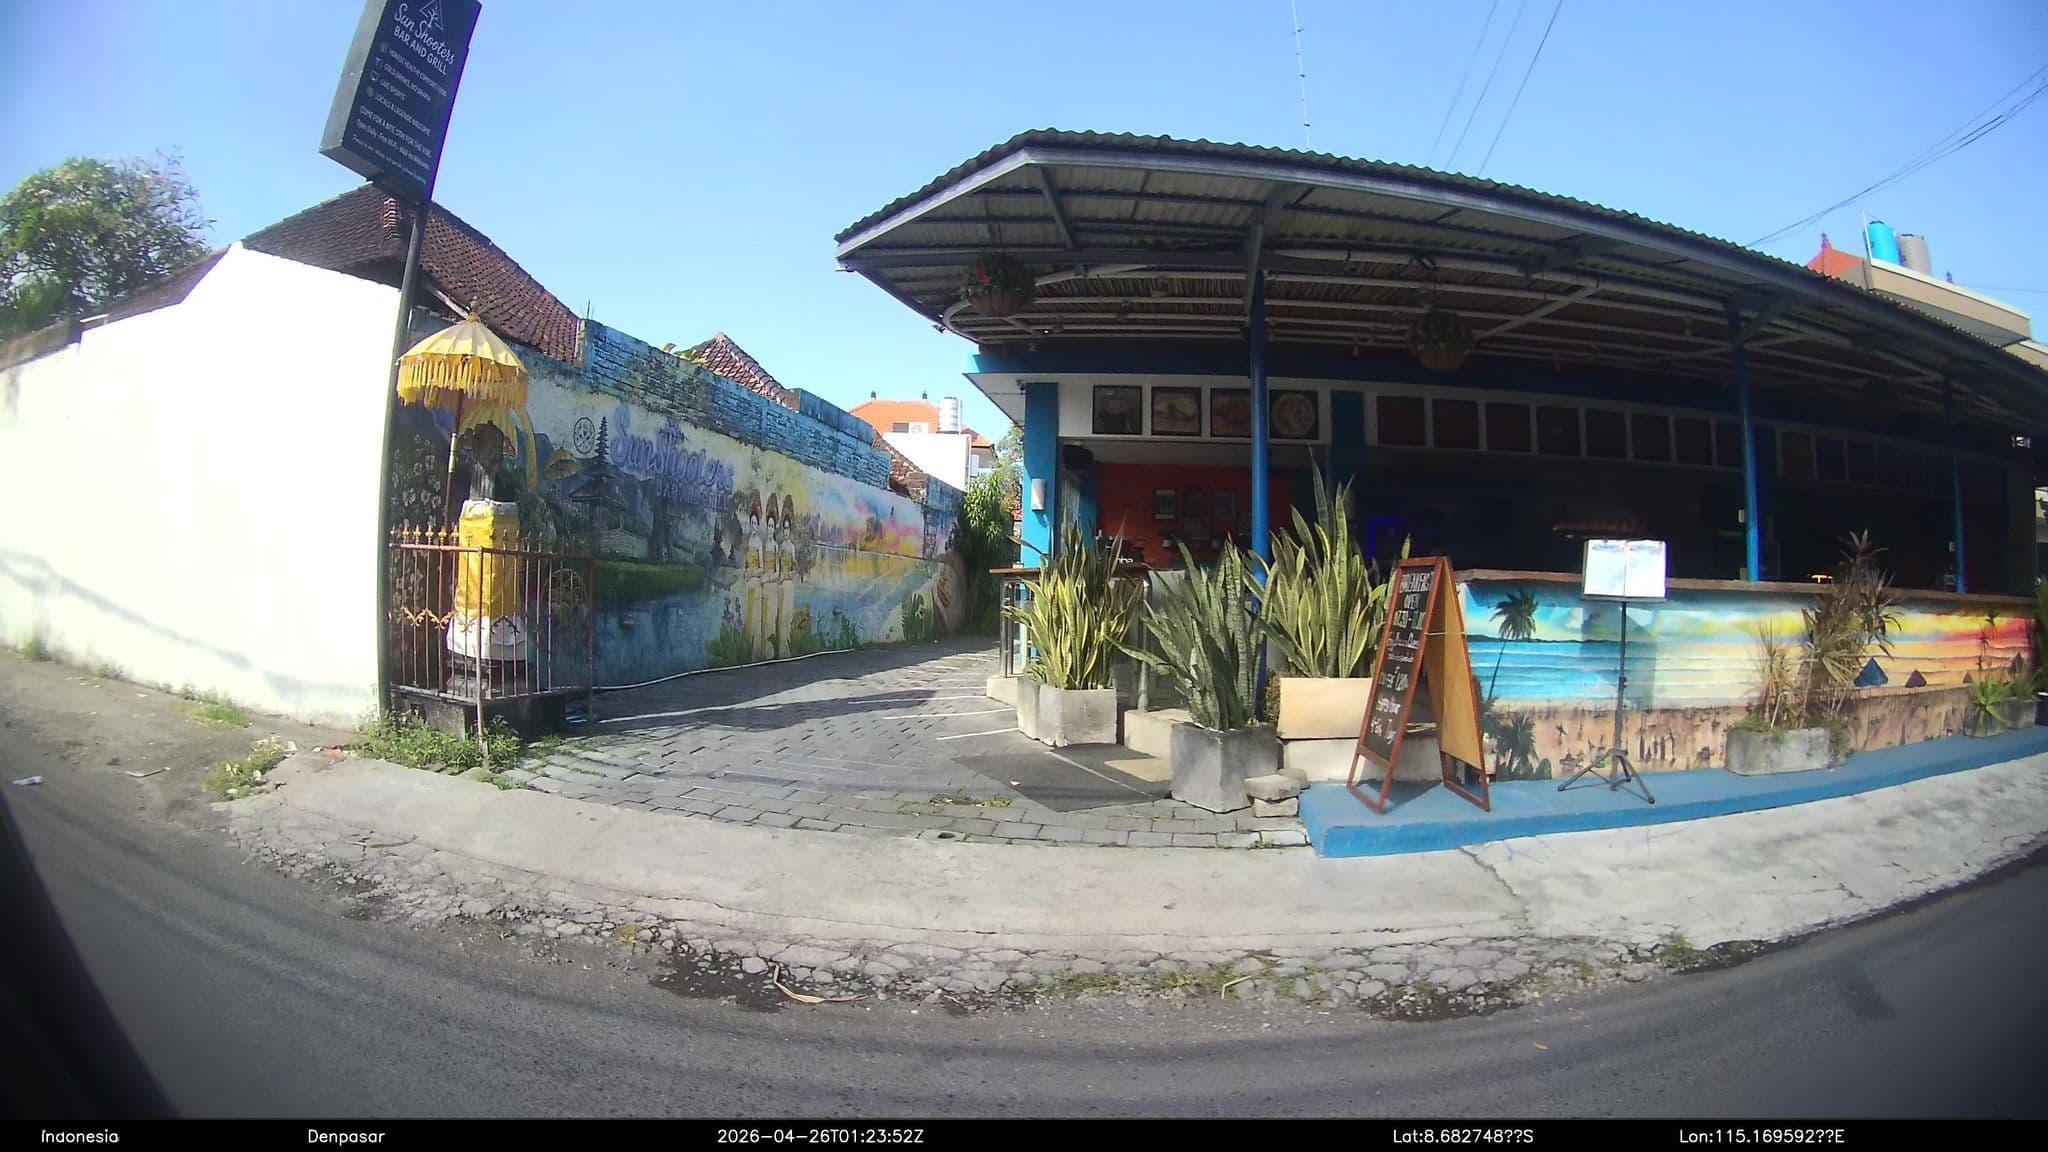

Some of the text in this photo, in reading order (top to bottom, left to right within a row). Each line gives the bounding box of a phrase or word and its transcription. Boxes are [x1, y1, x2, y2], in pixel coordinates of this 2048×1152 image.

[393, 25, 446, 75] BAR AND GRILL
[395, 3, 455, 65] Sun Shooters
[610, 403, 656, 470] Sun
